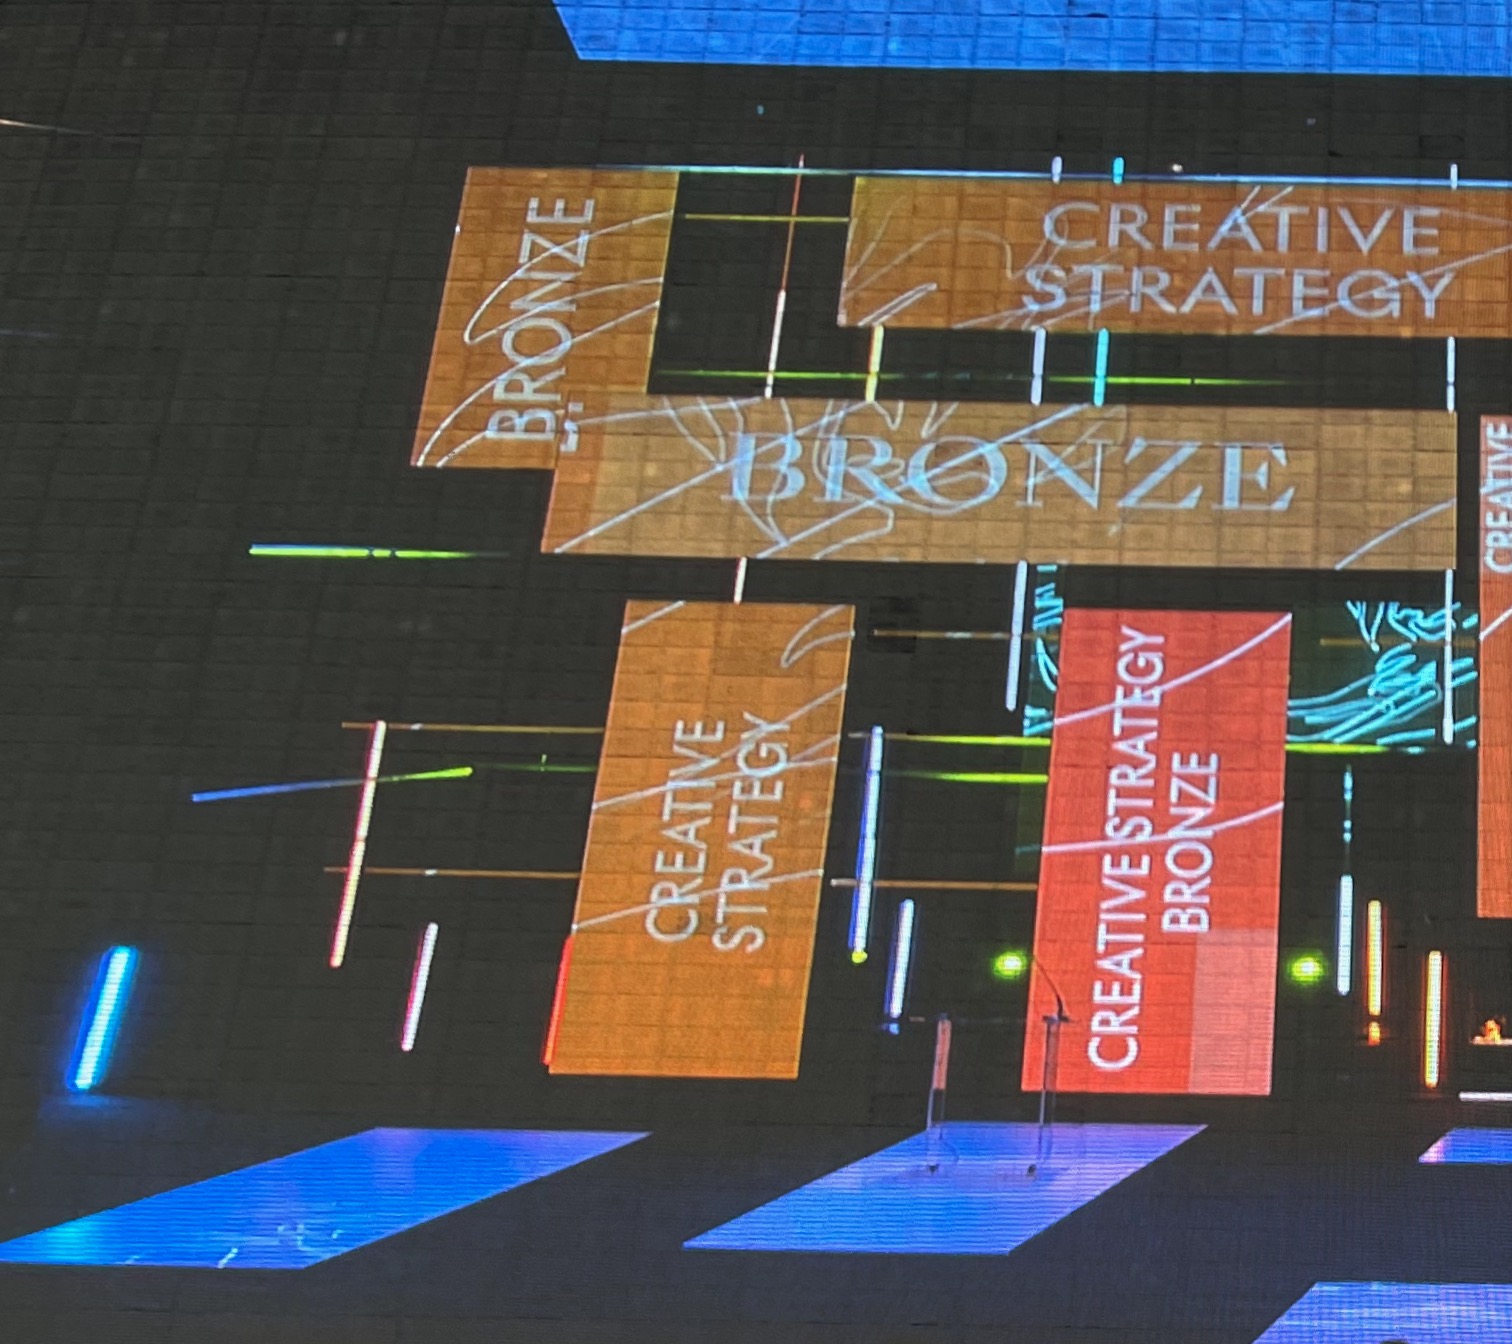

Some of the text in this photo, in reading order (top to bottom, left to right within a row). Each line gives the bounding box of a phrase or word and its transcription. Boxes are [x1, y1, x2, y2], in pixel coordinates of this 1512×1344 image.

[485, 197, 594, 441] BRONZE
[1022, 265, 1455, 319] STRATEGY
[1044, 201, 1440, 256] CREATIVE
[719, 431, 1295, 511] BRONZE
[644, 719, 727, 945] CREATIVE
[712, 711, 791, 955] STRATEGY
[1086, 625, 1166, 1071] CREATIVE STRATEGY
[1161, 750, 1219, 934] BRONZE
